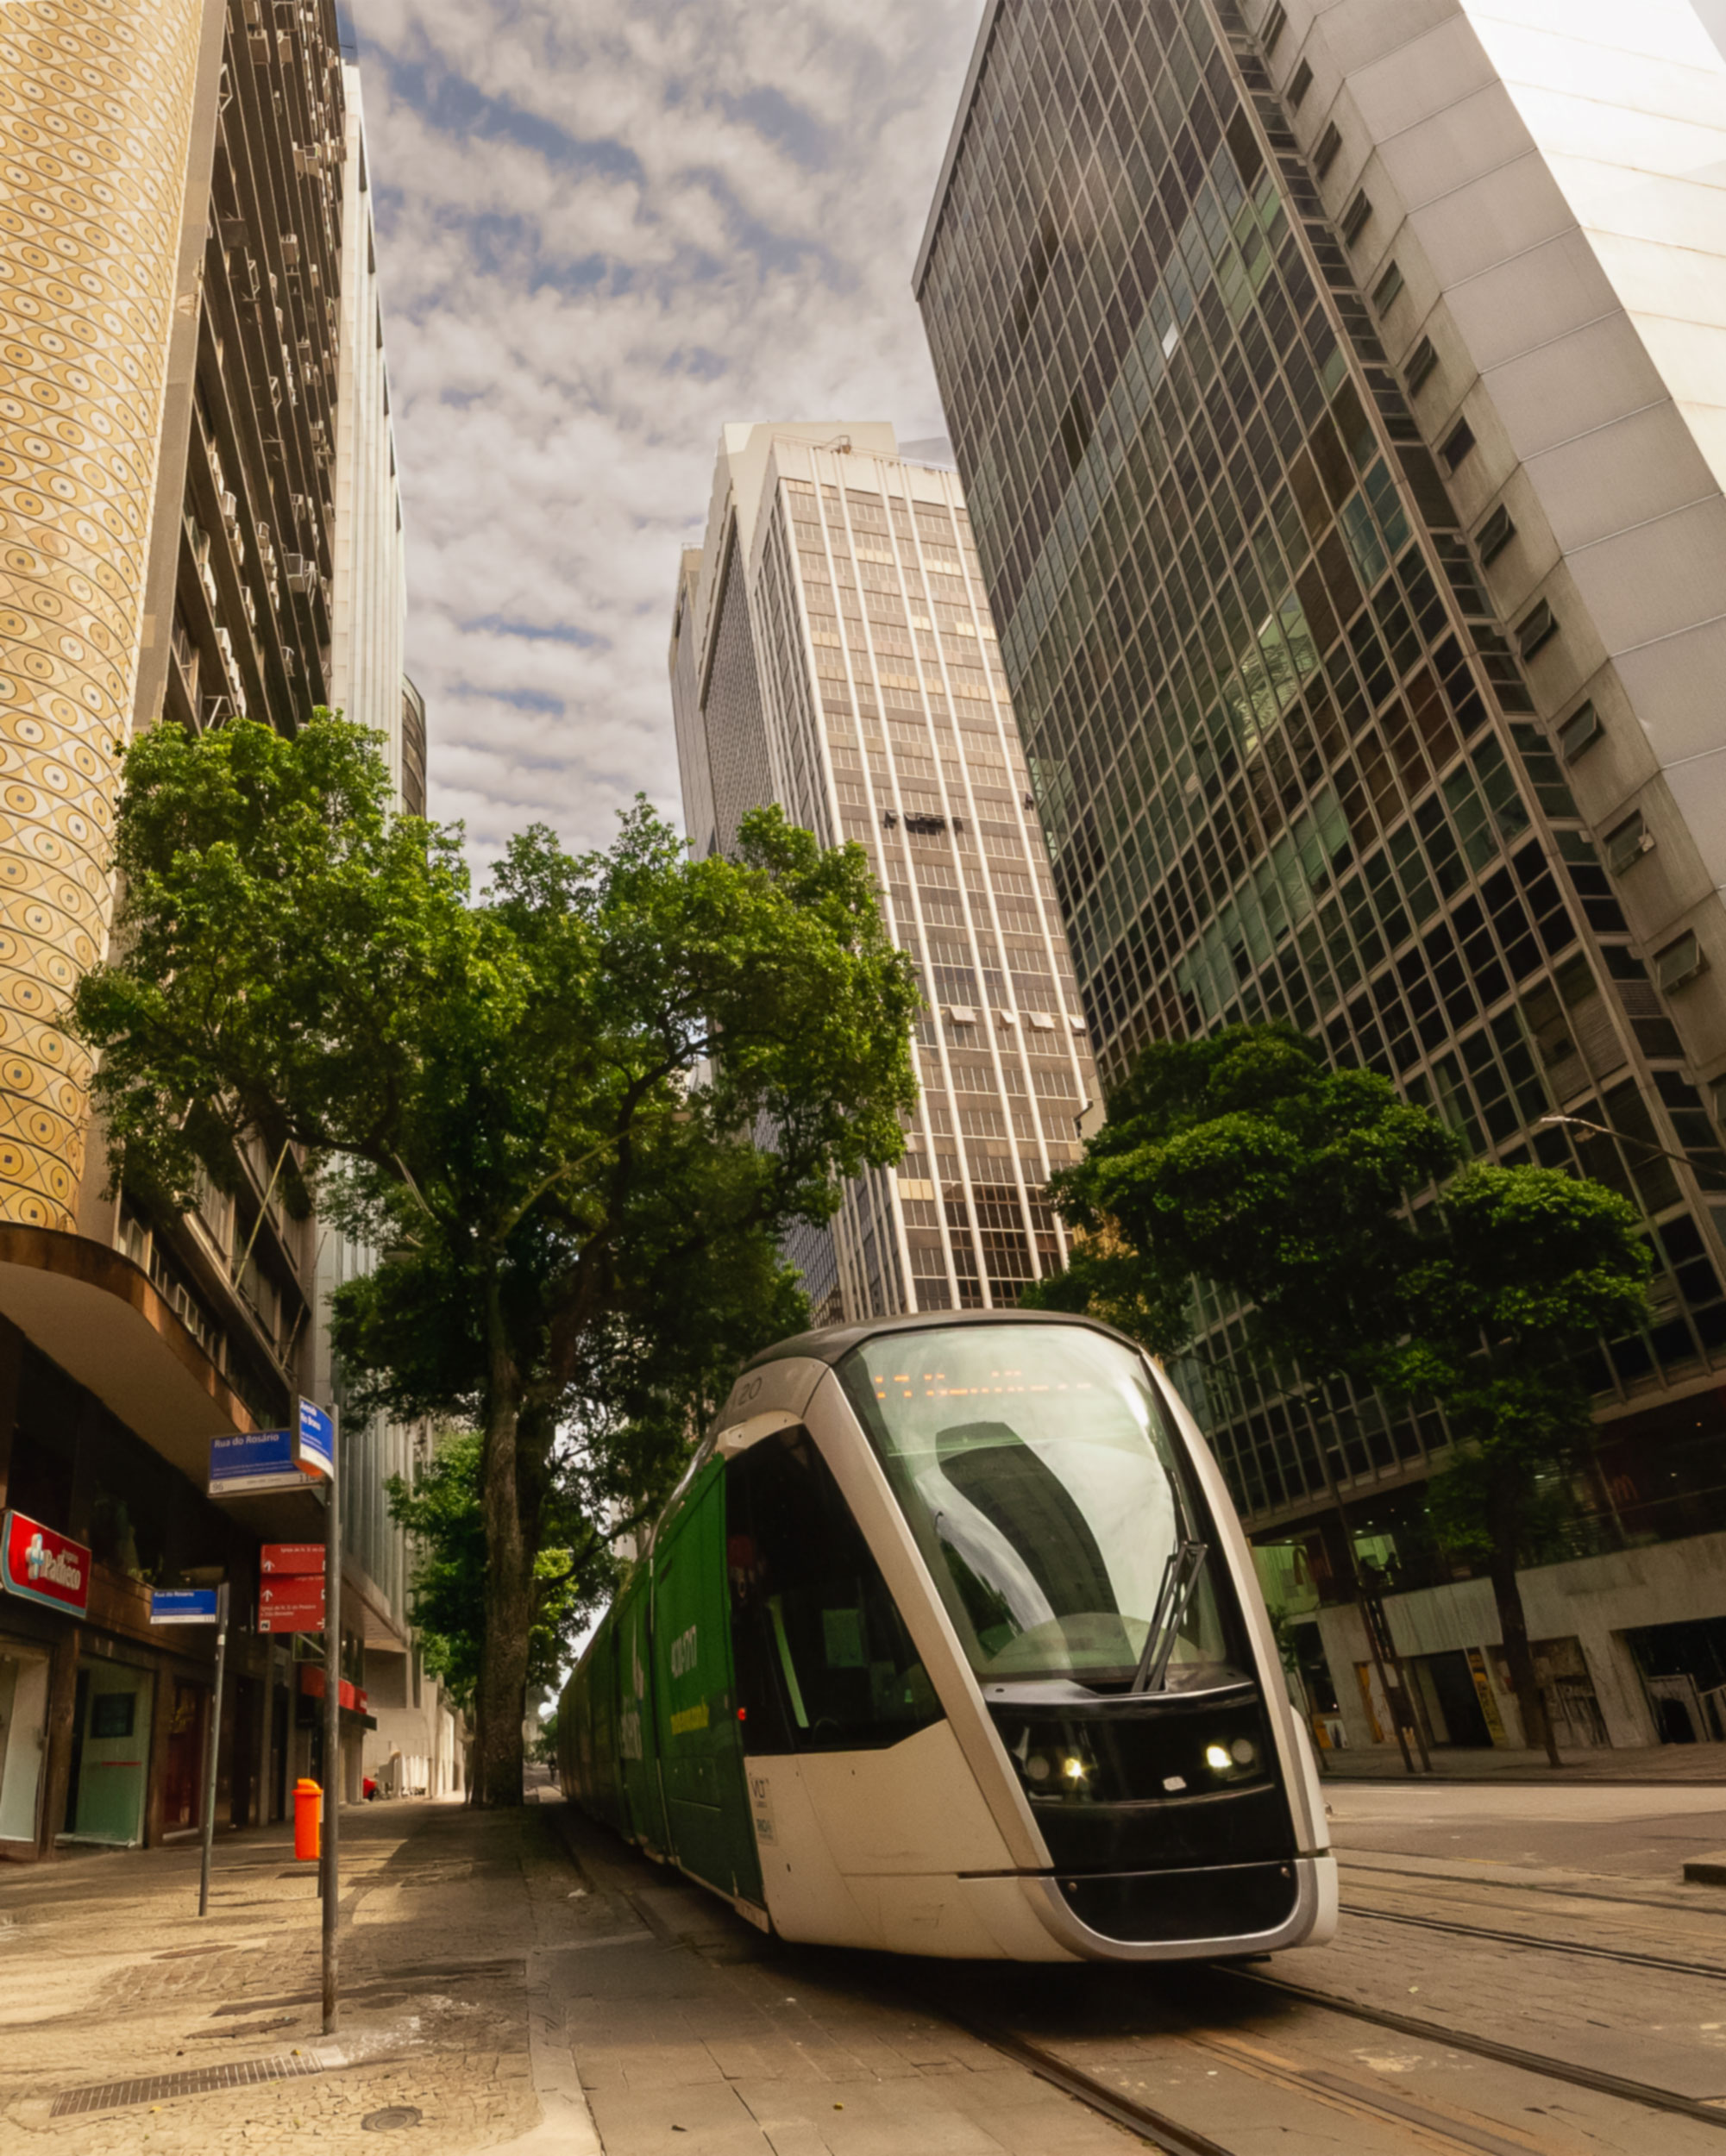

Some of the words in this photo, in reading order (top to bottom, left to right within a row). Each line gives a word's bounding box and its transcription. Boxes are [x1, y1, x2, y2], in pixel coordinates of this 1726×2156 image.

[214, 1438, 231, 1449] Rua
[232, 1436, 244, 1446] do
[245, 1432, 280, 1445] Rosário
[40, 1549, 81, 1590] Pacheco
